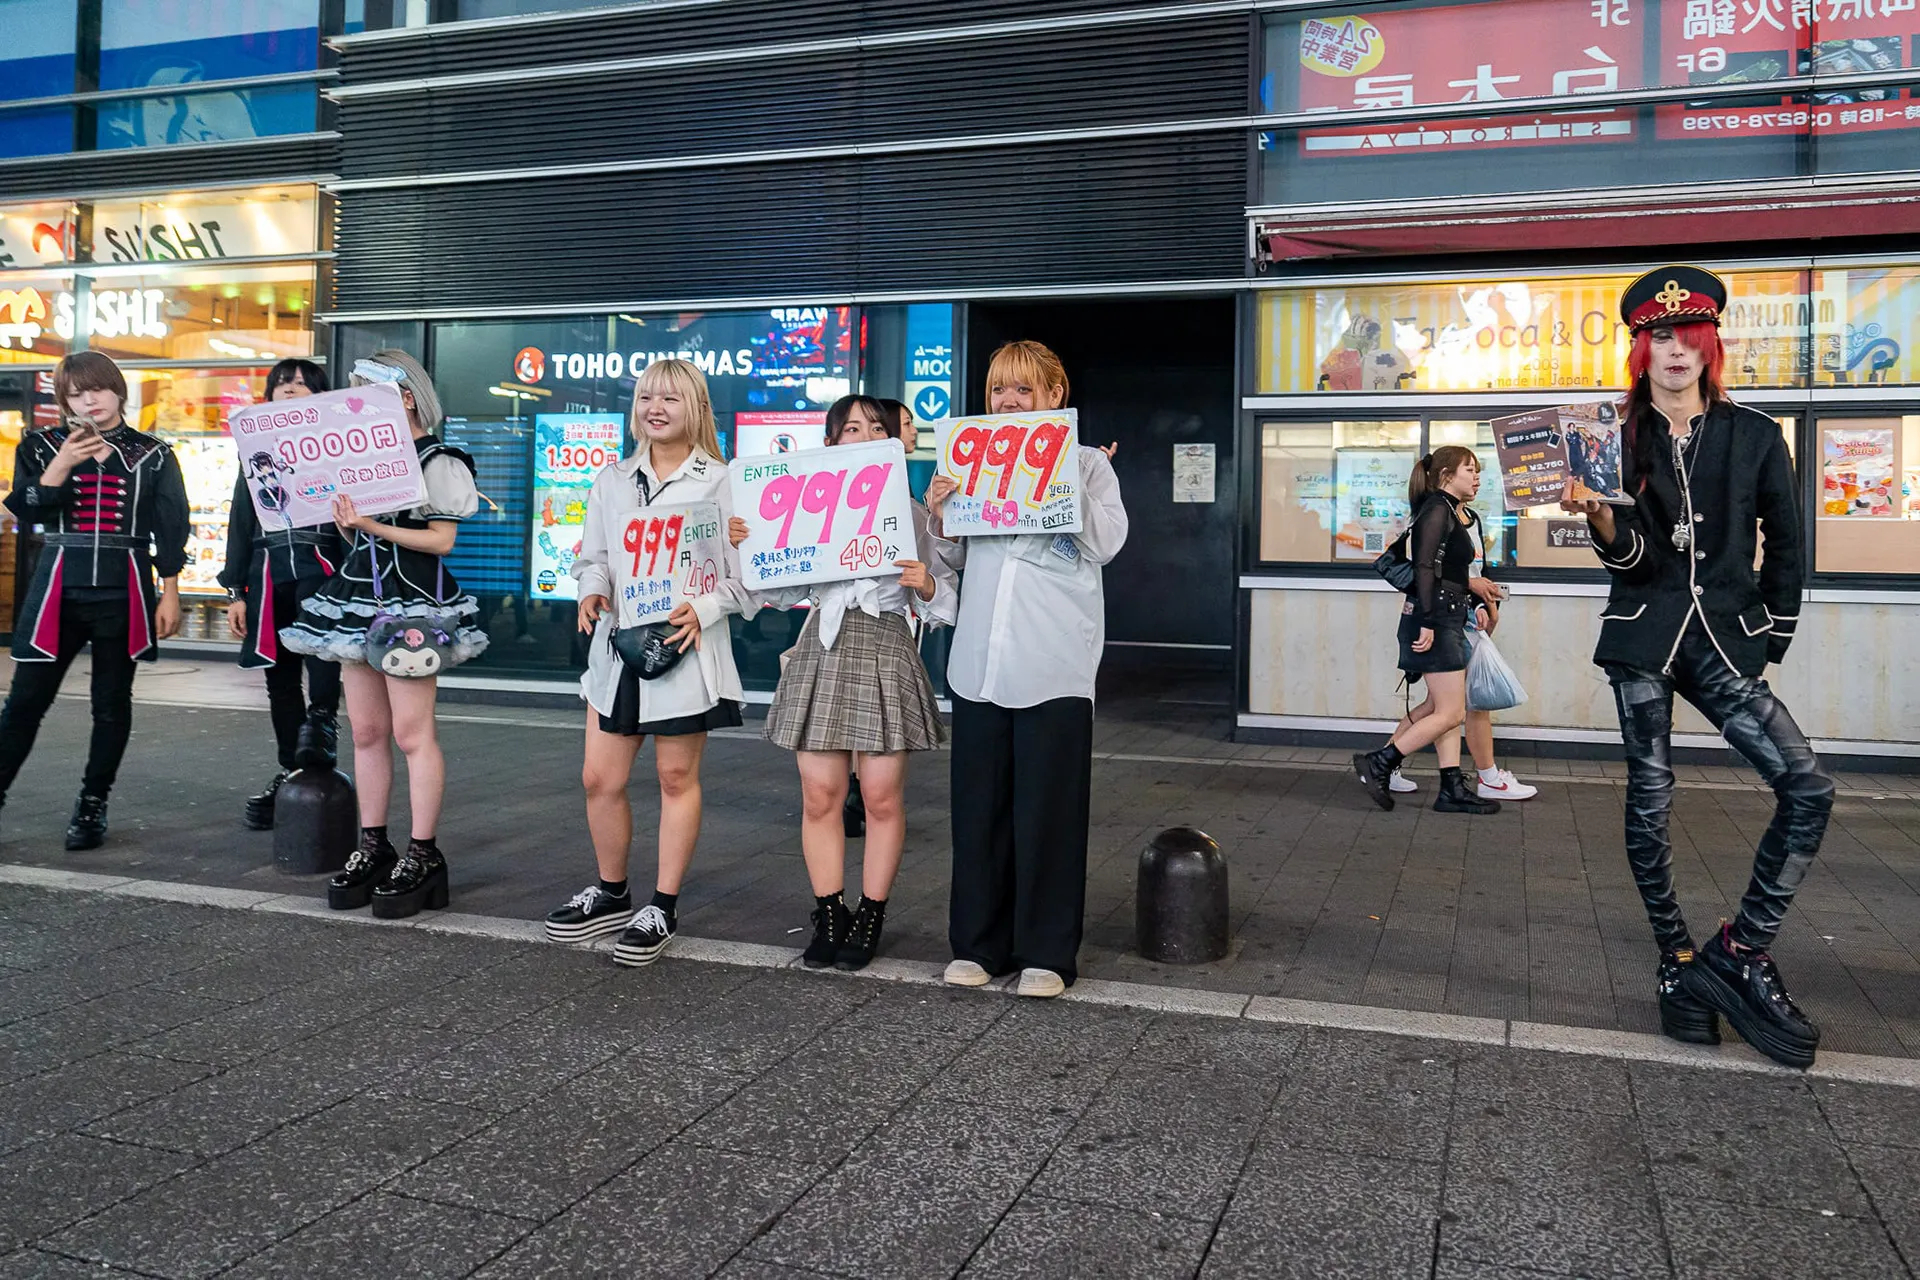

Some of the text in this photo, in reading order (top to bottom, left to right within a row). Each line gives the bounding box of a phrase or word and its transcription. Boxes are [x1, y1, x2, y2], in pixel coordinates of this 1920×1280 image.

[552, 353, 623, 379] TOHO
[1495, 373, 1589, 389] made in Japan
[240, 408, 320, 434] 初回60分
[279, 423, 398, 465] 1000円
[340, 460, 408, 485] 飲み放題
[744, 463, 790, 482] ENTER
[952, 422, 1070, 503] 999
[982, 500, 1019, 529] 40
[1018, 514, 1038, 527] min
[1041, 511, 1074, 528] ENTER
[684, 521, 718, 544] ENTER
